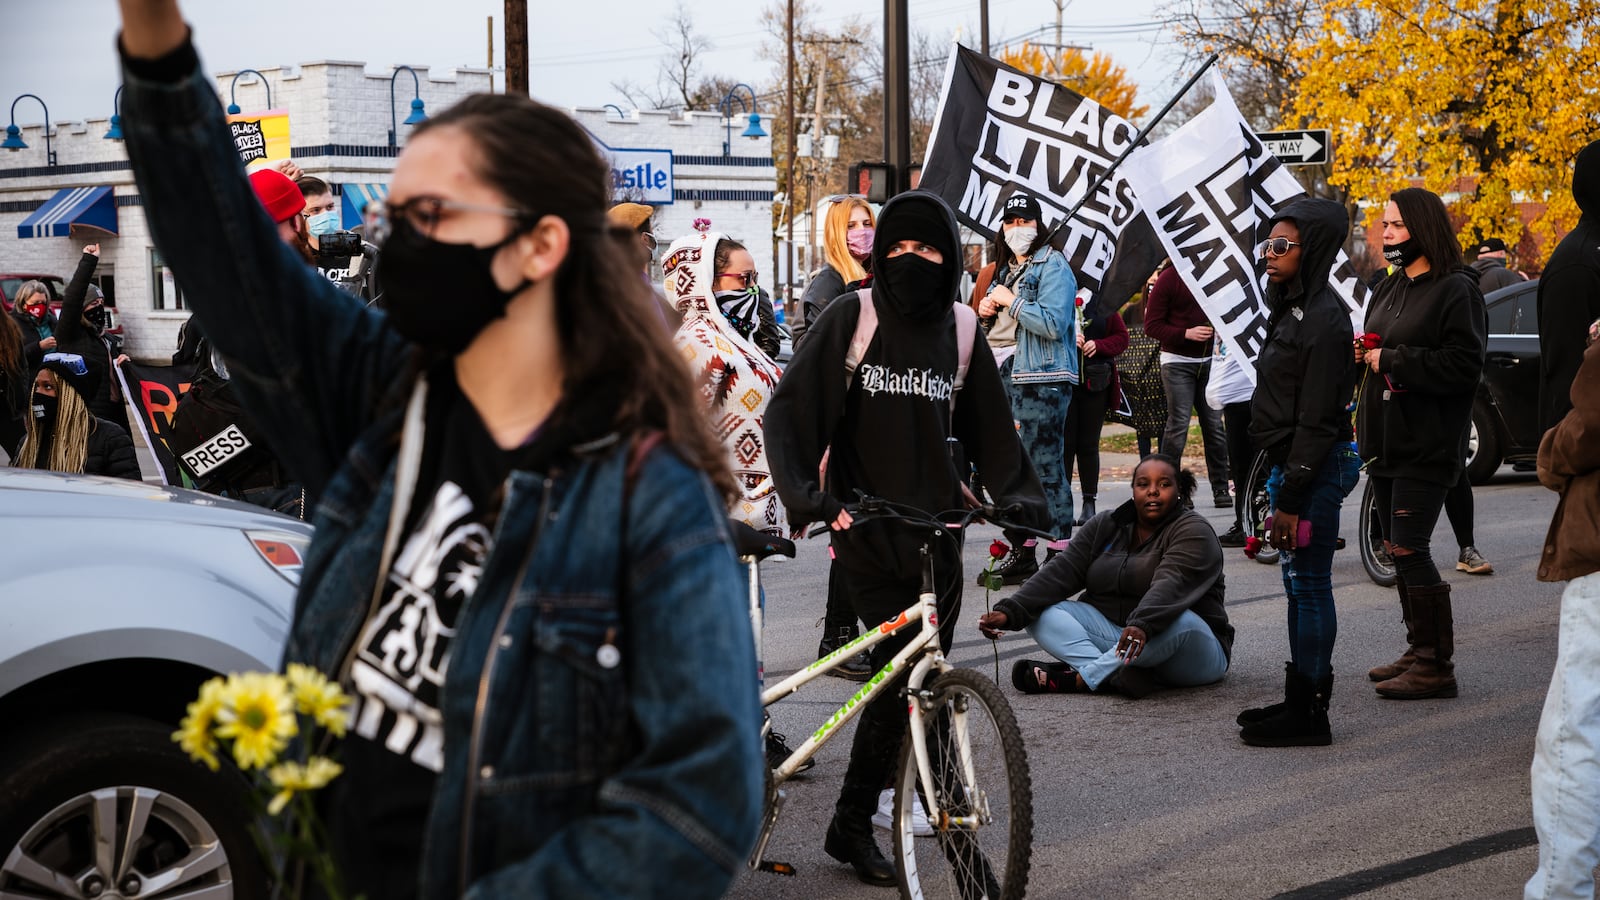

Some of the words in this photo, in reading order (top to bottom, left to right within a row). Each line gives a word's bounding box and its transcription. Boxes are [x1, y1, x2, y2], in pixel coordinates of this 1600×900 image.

[231, 123, 259, 137] BLACK
[987, 68, 1141, 158] BLAC
[240, 148, 264, 161] ATTER
[1279, 142, 1302, 153] WAY
[611, 163, 667, 190] astle
[980, 121, 1136, 227] LIVES
[1157, 191, 1267, 366] MATTE
[185, 430, 246, 474] PRESS
